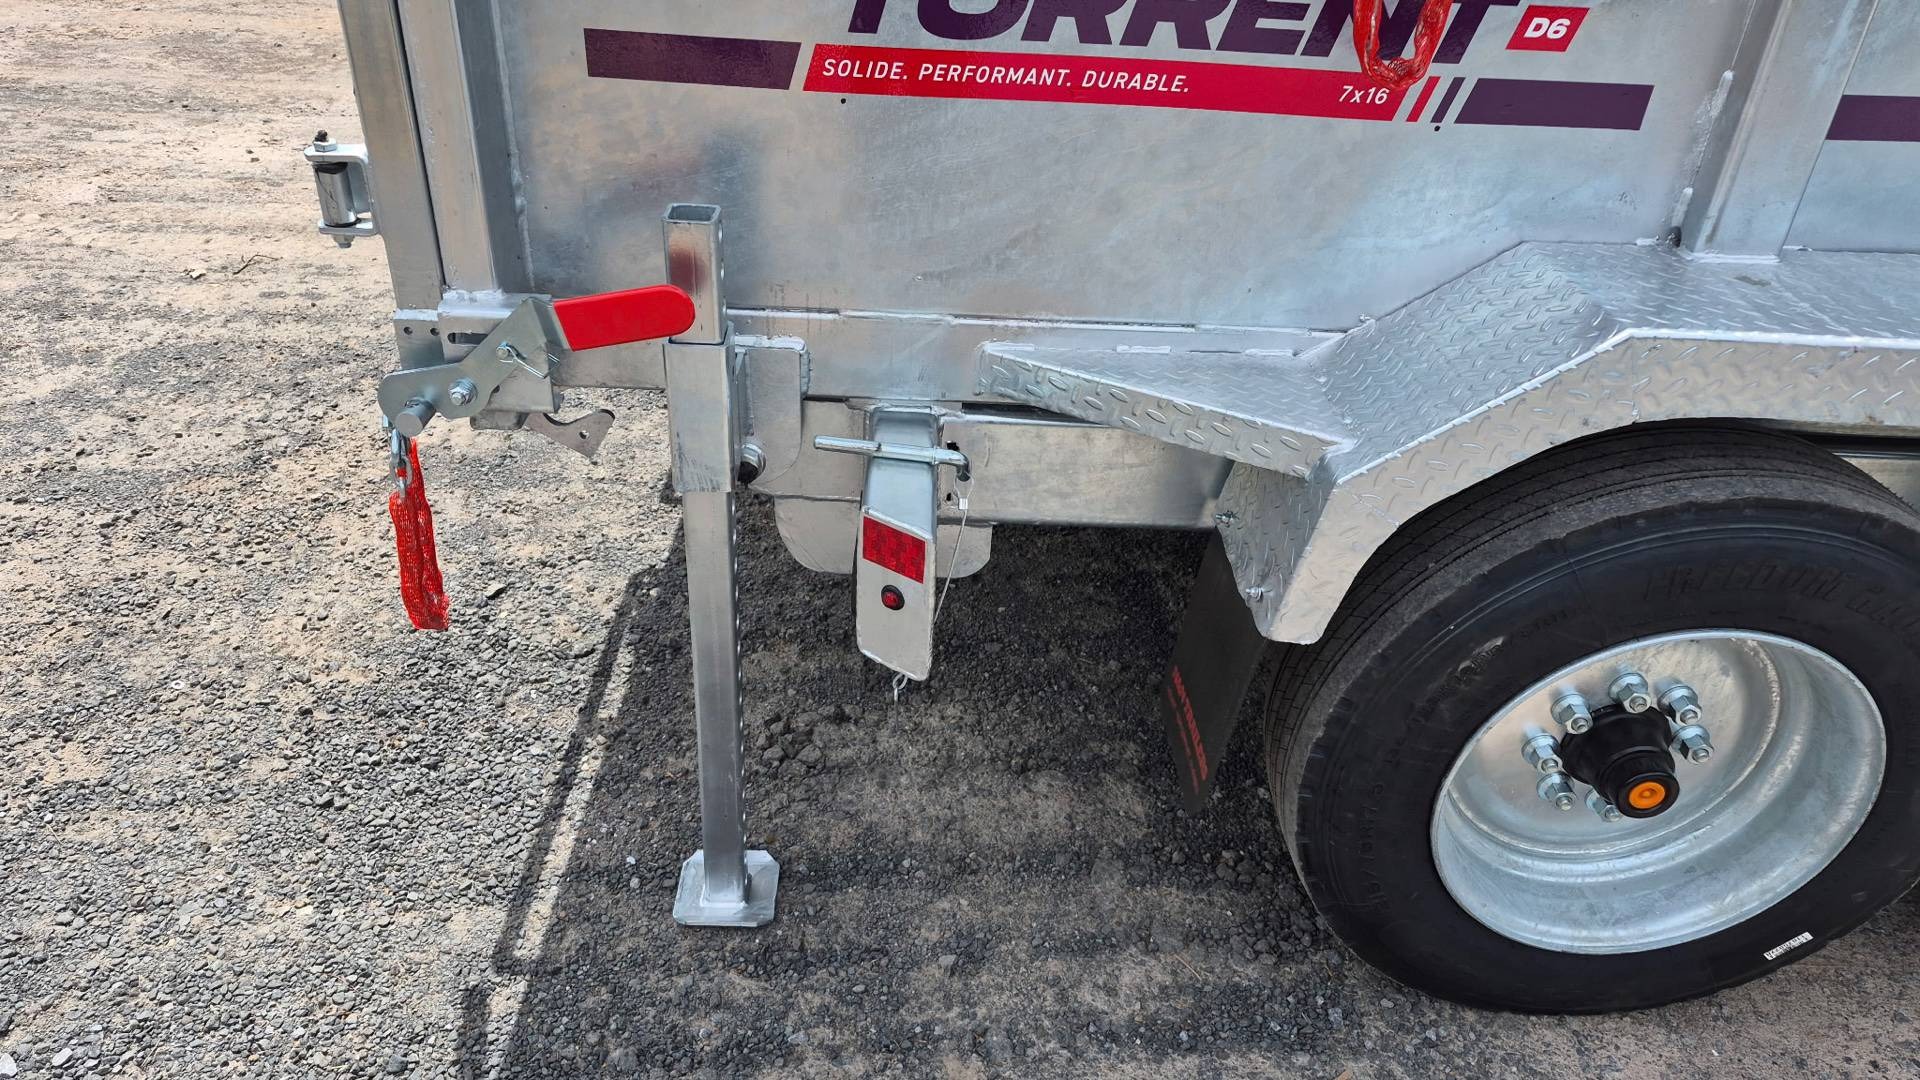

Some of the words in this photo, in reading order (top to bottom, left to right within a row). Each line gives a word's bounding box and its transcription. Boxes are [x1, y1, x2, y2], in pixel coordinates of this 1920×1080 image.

[1523, 17, 1571, 39] D6
[822, 58, 908, 80] SOLIDE.
[918, 63, 1071, 87] PERFORMANT.
[1081, 70, 1189, 93] DURABLE.
[1339, 85, 1389, 105] 7x16
